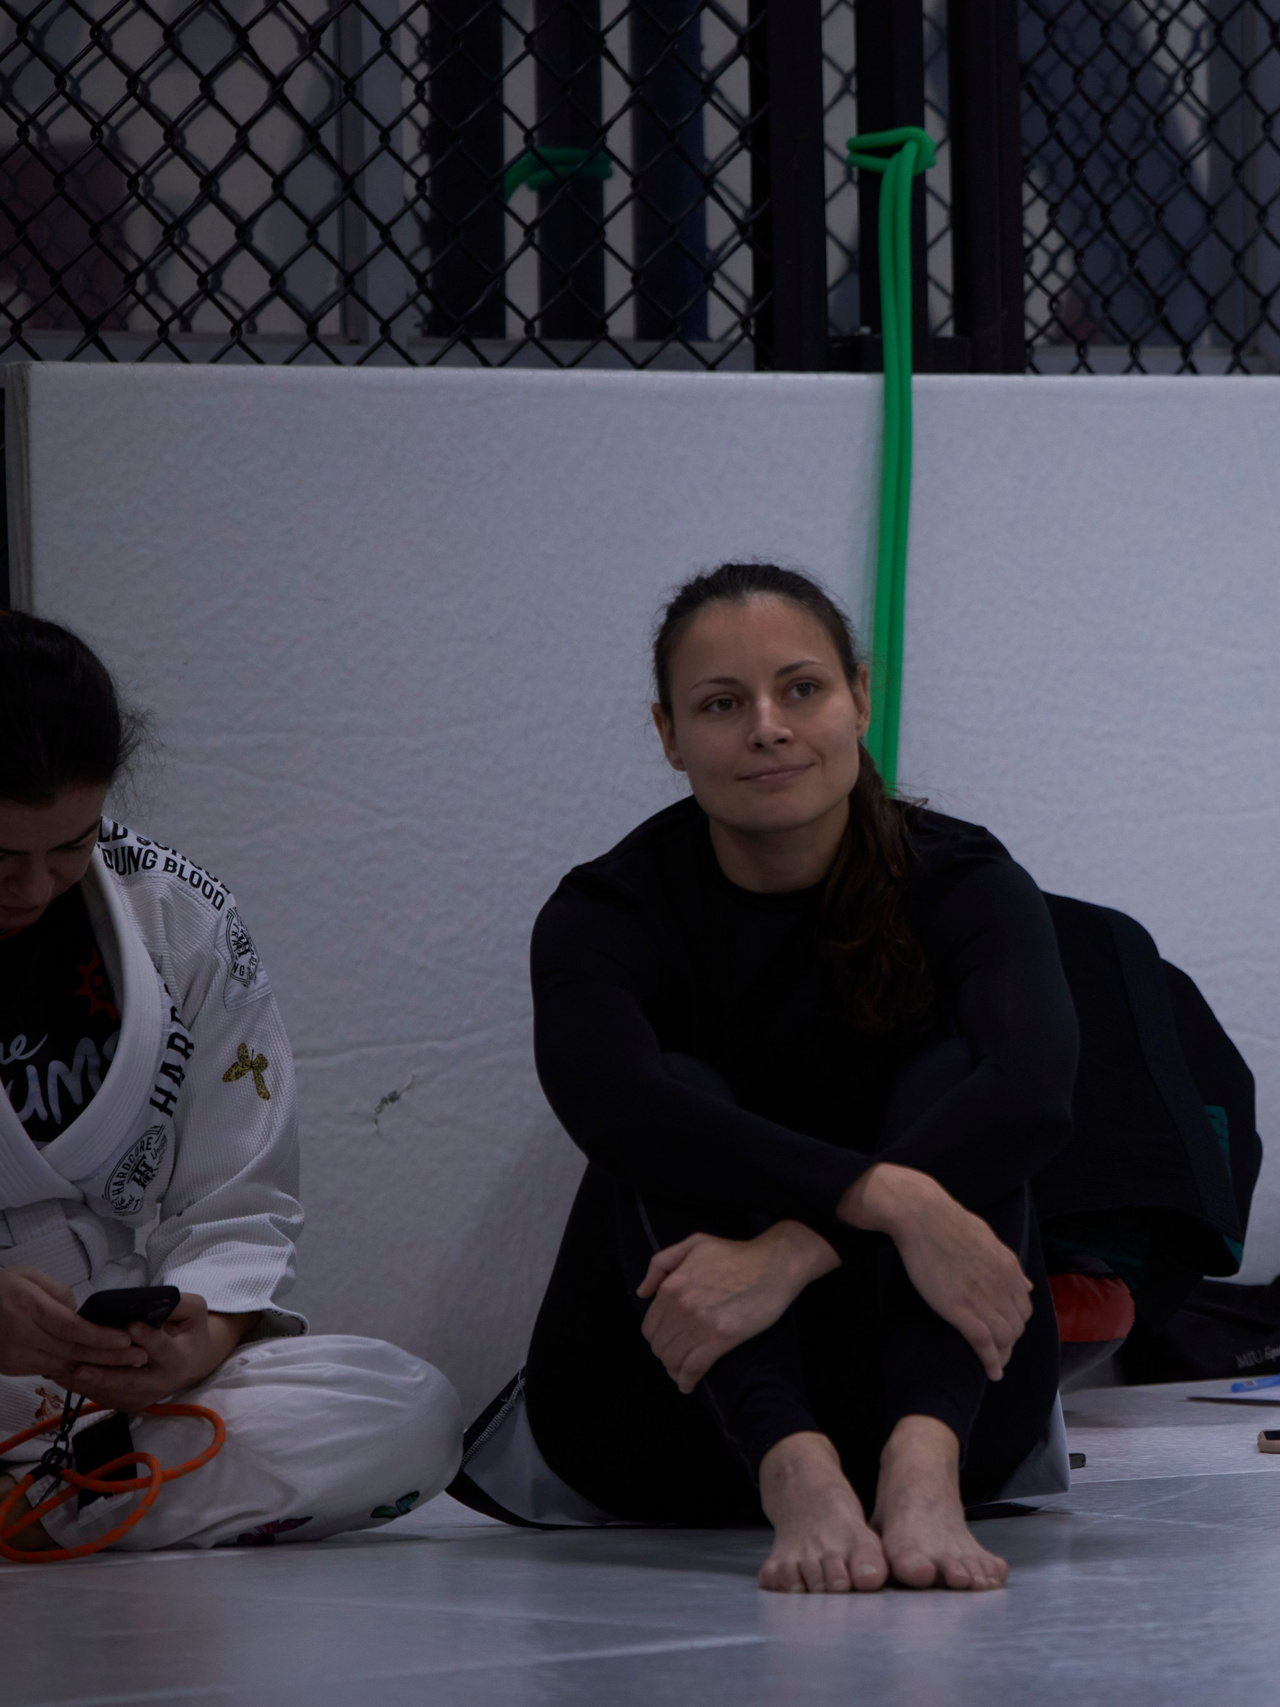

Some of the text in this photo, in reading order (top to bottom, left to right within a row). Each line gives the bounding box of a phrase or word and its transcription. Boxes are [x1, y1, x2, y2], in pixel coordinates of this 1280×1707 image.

[97, 843, 159, 876] OUNG
[163, 857, 225, 911] BLOOD
[112, 1136, 153, 1196] HARDCORE
